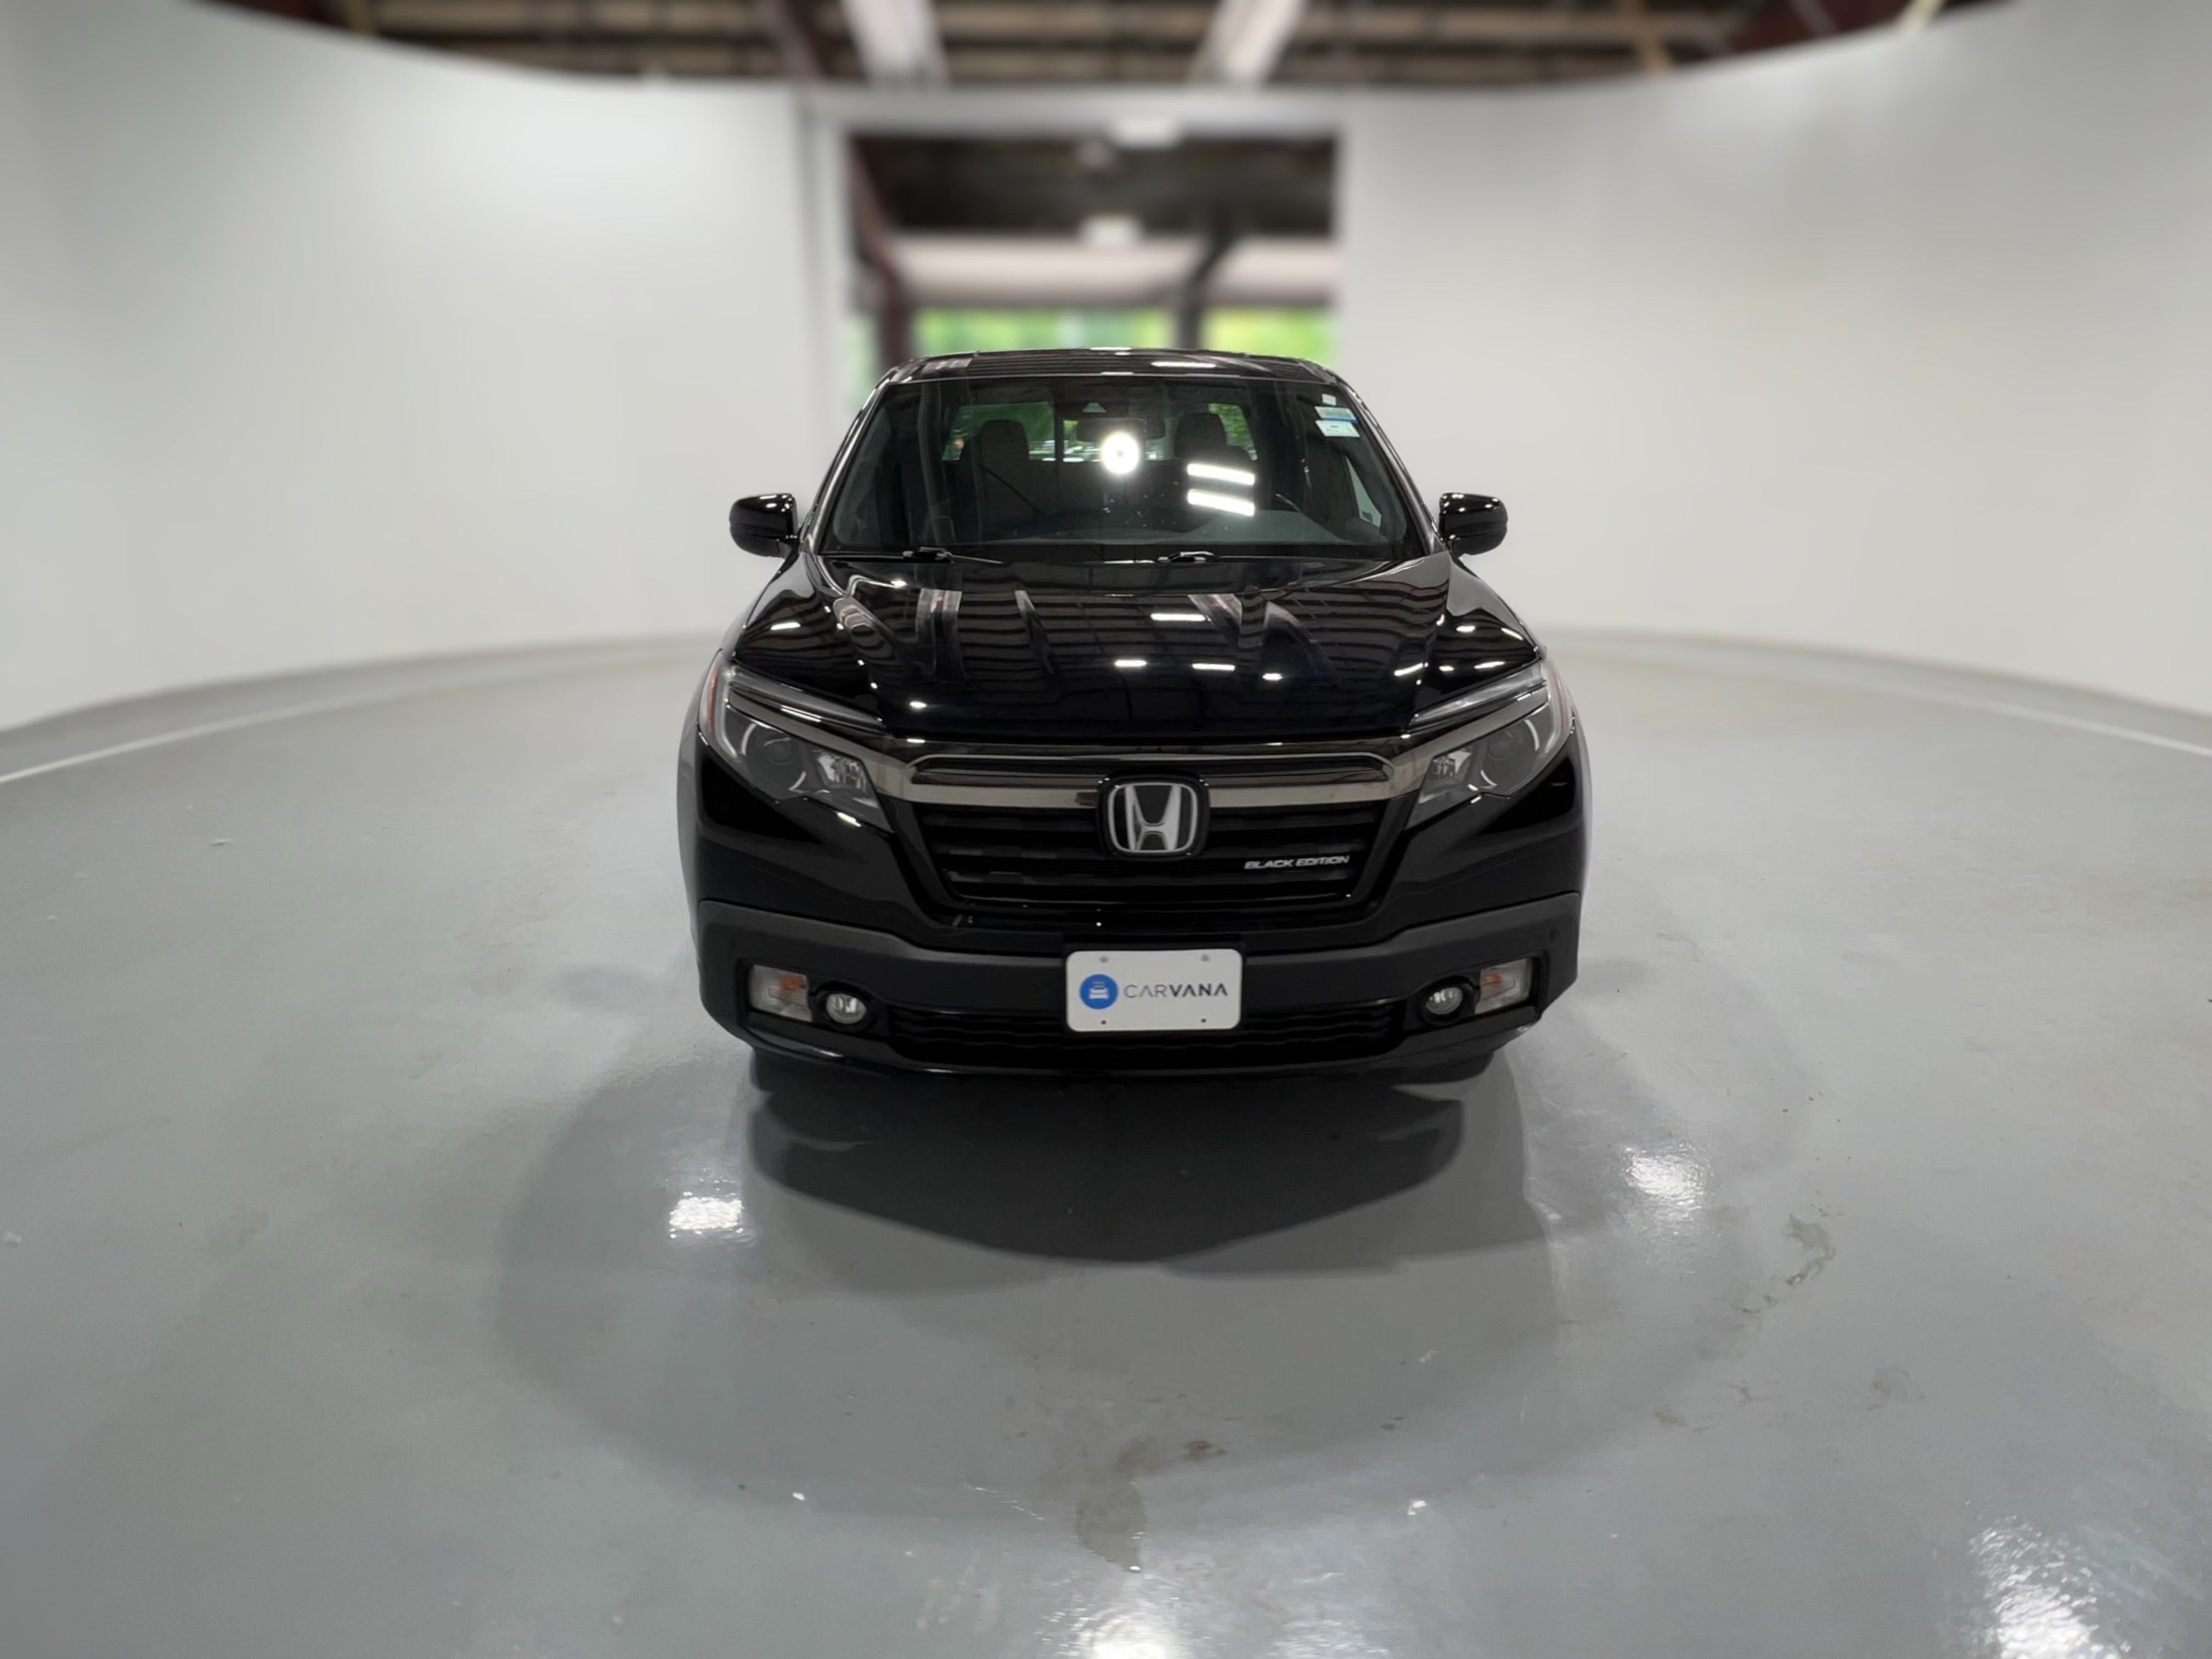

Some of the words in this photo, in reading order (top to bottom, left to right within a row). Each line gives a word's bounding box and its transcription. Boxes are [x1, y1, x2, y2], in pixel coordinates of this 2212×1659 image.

[1244, 859, 1294, 869] BLACK
[1296, 855, 1350, 867] EDITION
[1124, 983, 1228, 998] CARVANA
